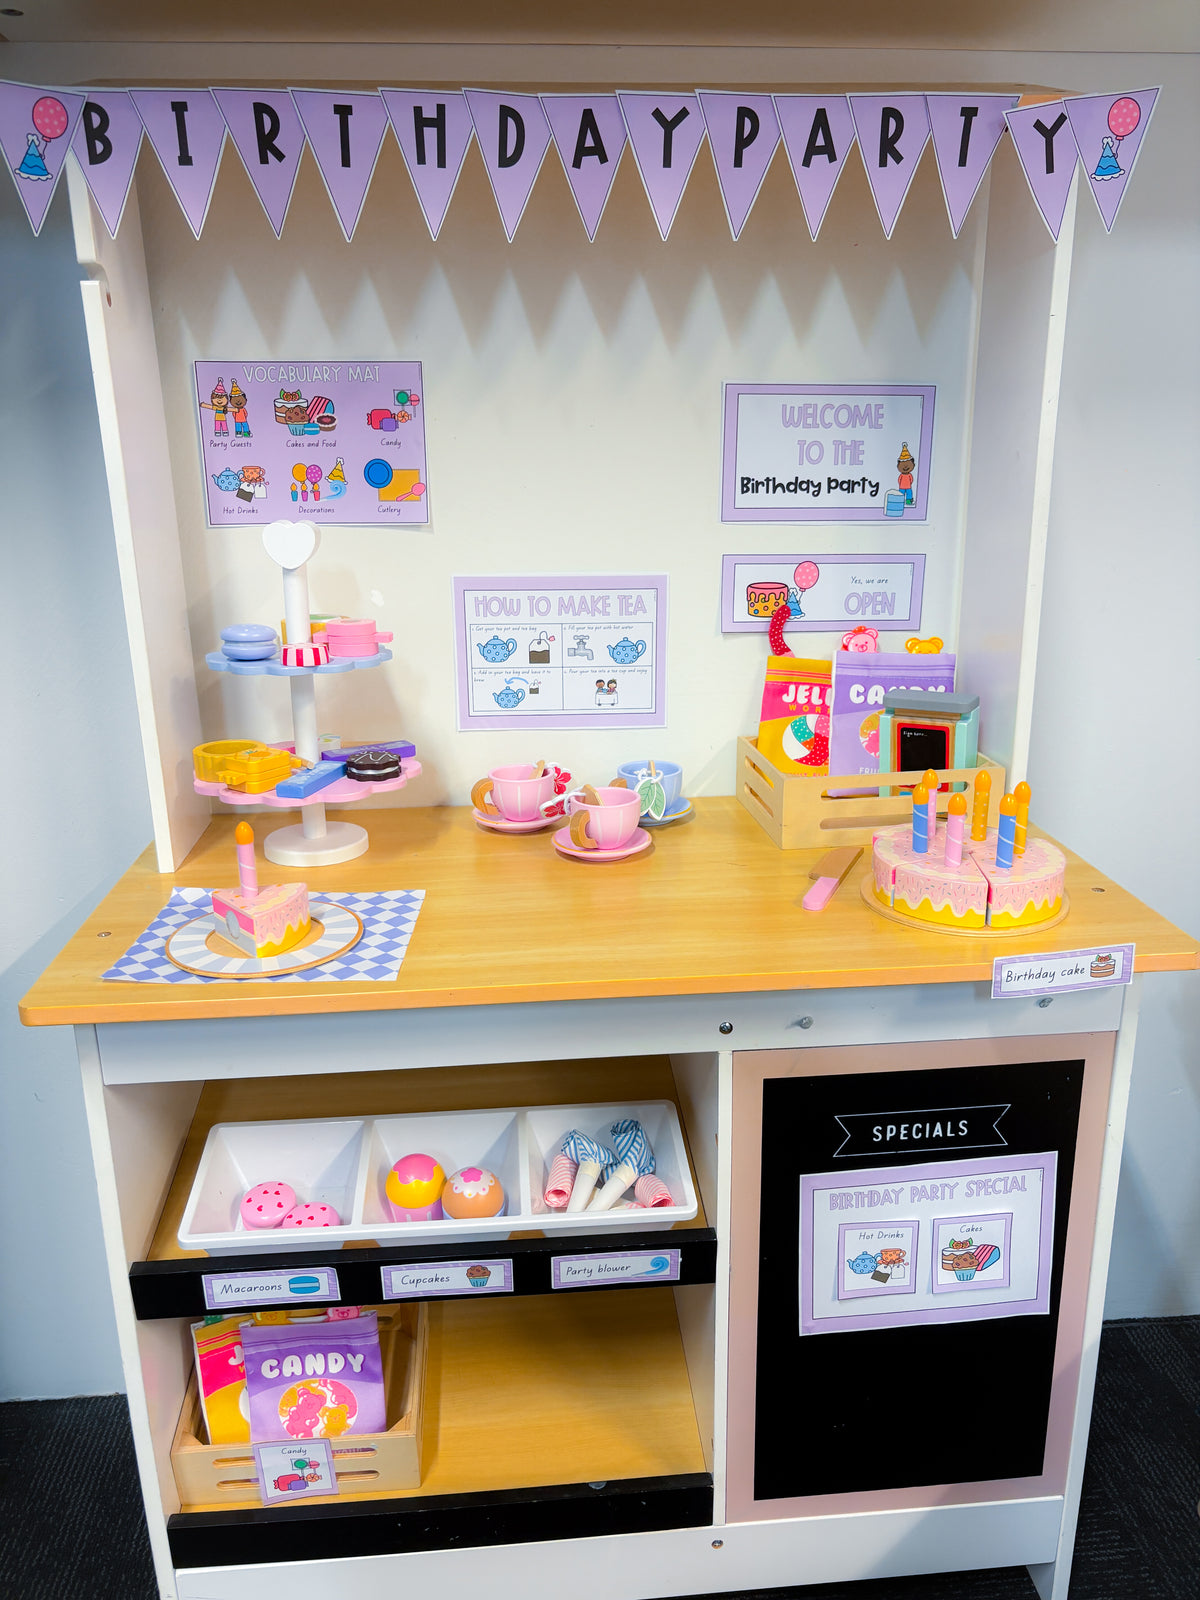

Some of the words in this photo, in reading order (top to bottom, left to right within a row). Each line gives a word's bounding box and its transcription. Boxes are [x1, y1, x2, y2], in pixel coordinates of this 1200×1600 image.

[243, 366, 342, 383] VOCABULARY
[347, 366, 381, 383] MAT
[781, 404, 885, 429] WELCOME
[209, 440, 228, 450] Party
[230, 440, 252, 449] Guests
[286, 440, 305, 449] Cakes
[307, 439, 320, 448] and
[322, 439, 337, 448] Food
[380, 438, 402, 449] Candy
[797, 440, 824, 466] TO
[833, 440, 865, 466] THE
[740, 476, 822, 498] Birthday
[222, 506, 235, 515] Hot
[237, 506, 259, 514] Drinks
[298, 505, 335, 514] Decorations
[377, 505, 401, 516] Cutlery
[850, 576, 863, 586] Yes,
[474, 596, 522, 618] HOW
[527, 596, 552, 617] TO
[558, 595, 611, 617] MAKE
[617, 594, 648, 616] TEA
[843, 591, 897, 616] OPEN
[1005, 967, 1056, 984] Birthday
[1060, 963, 1086, 977] cake
[872, 1120, 969, 1142] SPECIALS
[829, 1186, 905, 1211] BIRTHDAY
[910, 1182, 960, 1204] PARTY
[965, 1175, 1027, 1197] SPECIAL
[858, 1231, 874, 1241] Hot
[877, 1230, 905, 1240] Drinks
[959, 1224, 983, 1233] Cakes
[566, 1266, 593, 1278] Party
[597, 1264, 632, 1273] blower
[401, 1273, 450, 1288] Cupcakes
[220, 1283, 283, 1295] Macaroons
[261, 1352, 365, 1379] CANDY
[281, 1447, 308, 1456] Candy
